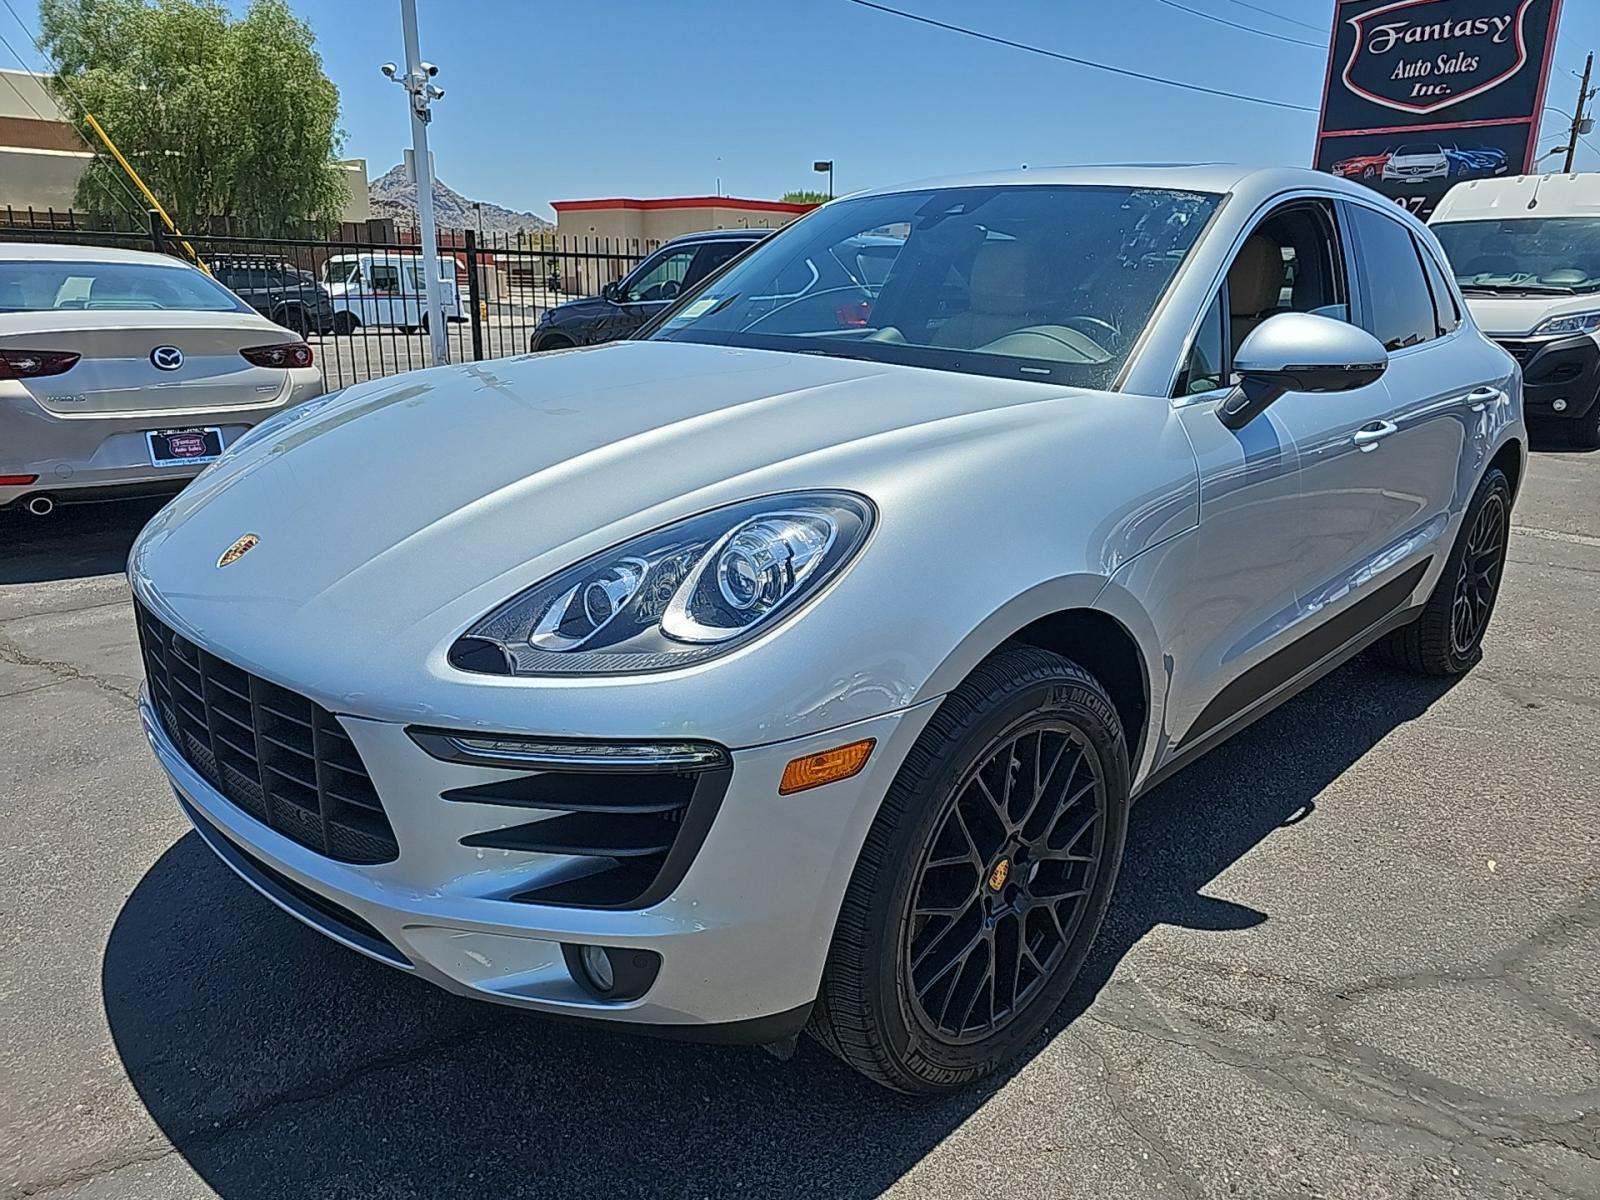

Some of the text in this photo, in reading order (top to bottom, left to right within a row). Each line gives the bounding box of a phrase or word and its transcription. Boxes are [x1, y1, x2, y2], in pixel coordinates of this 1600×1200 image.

[1368, 15, 1512, 54] Fantasy
[1391, 52, 1480, 80] Auto Sales
[1410, 83, 1451, 97] Inc.
[1070, 688, 1119, 736] MICHELIN
[906, 1054, 974, 1083] MICHELIN
